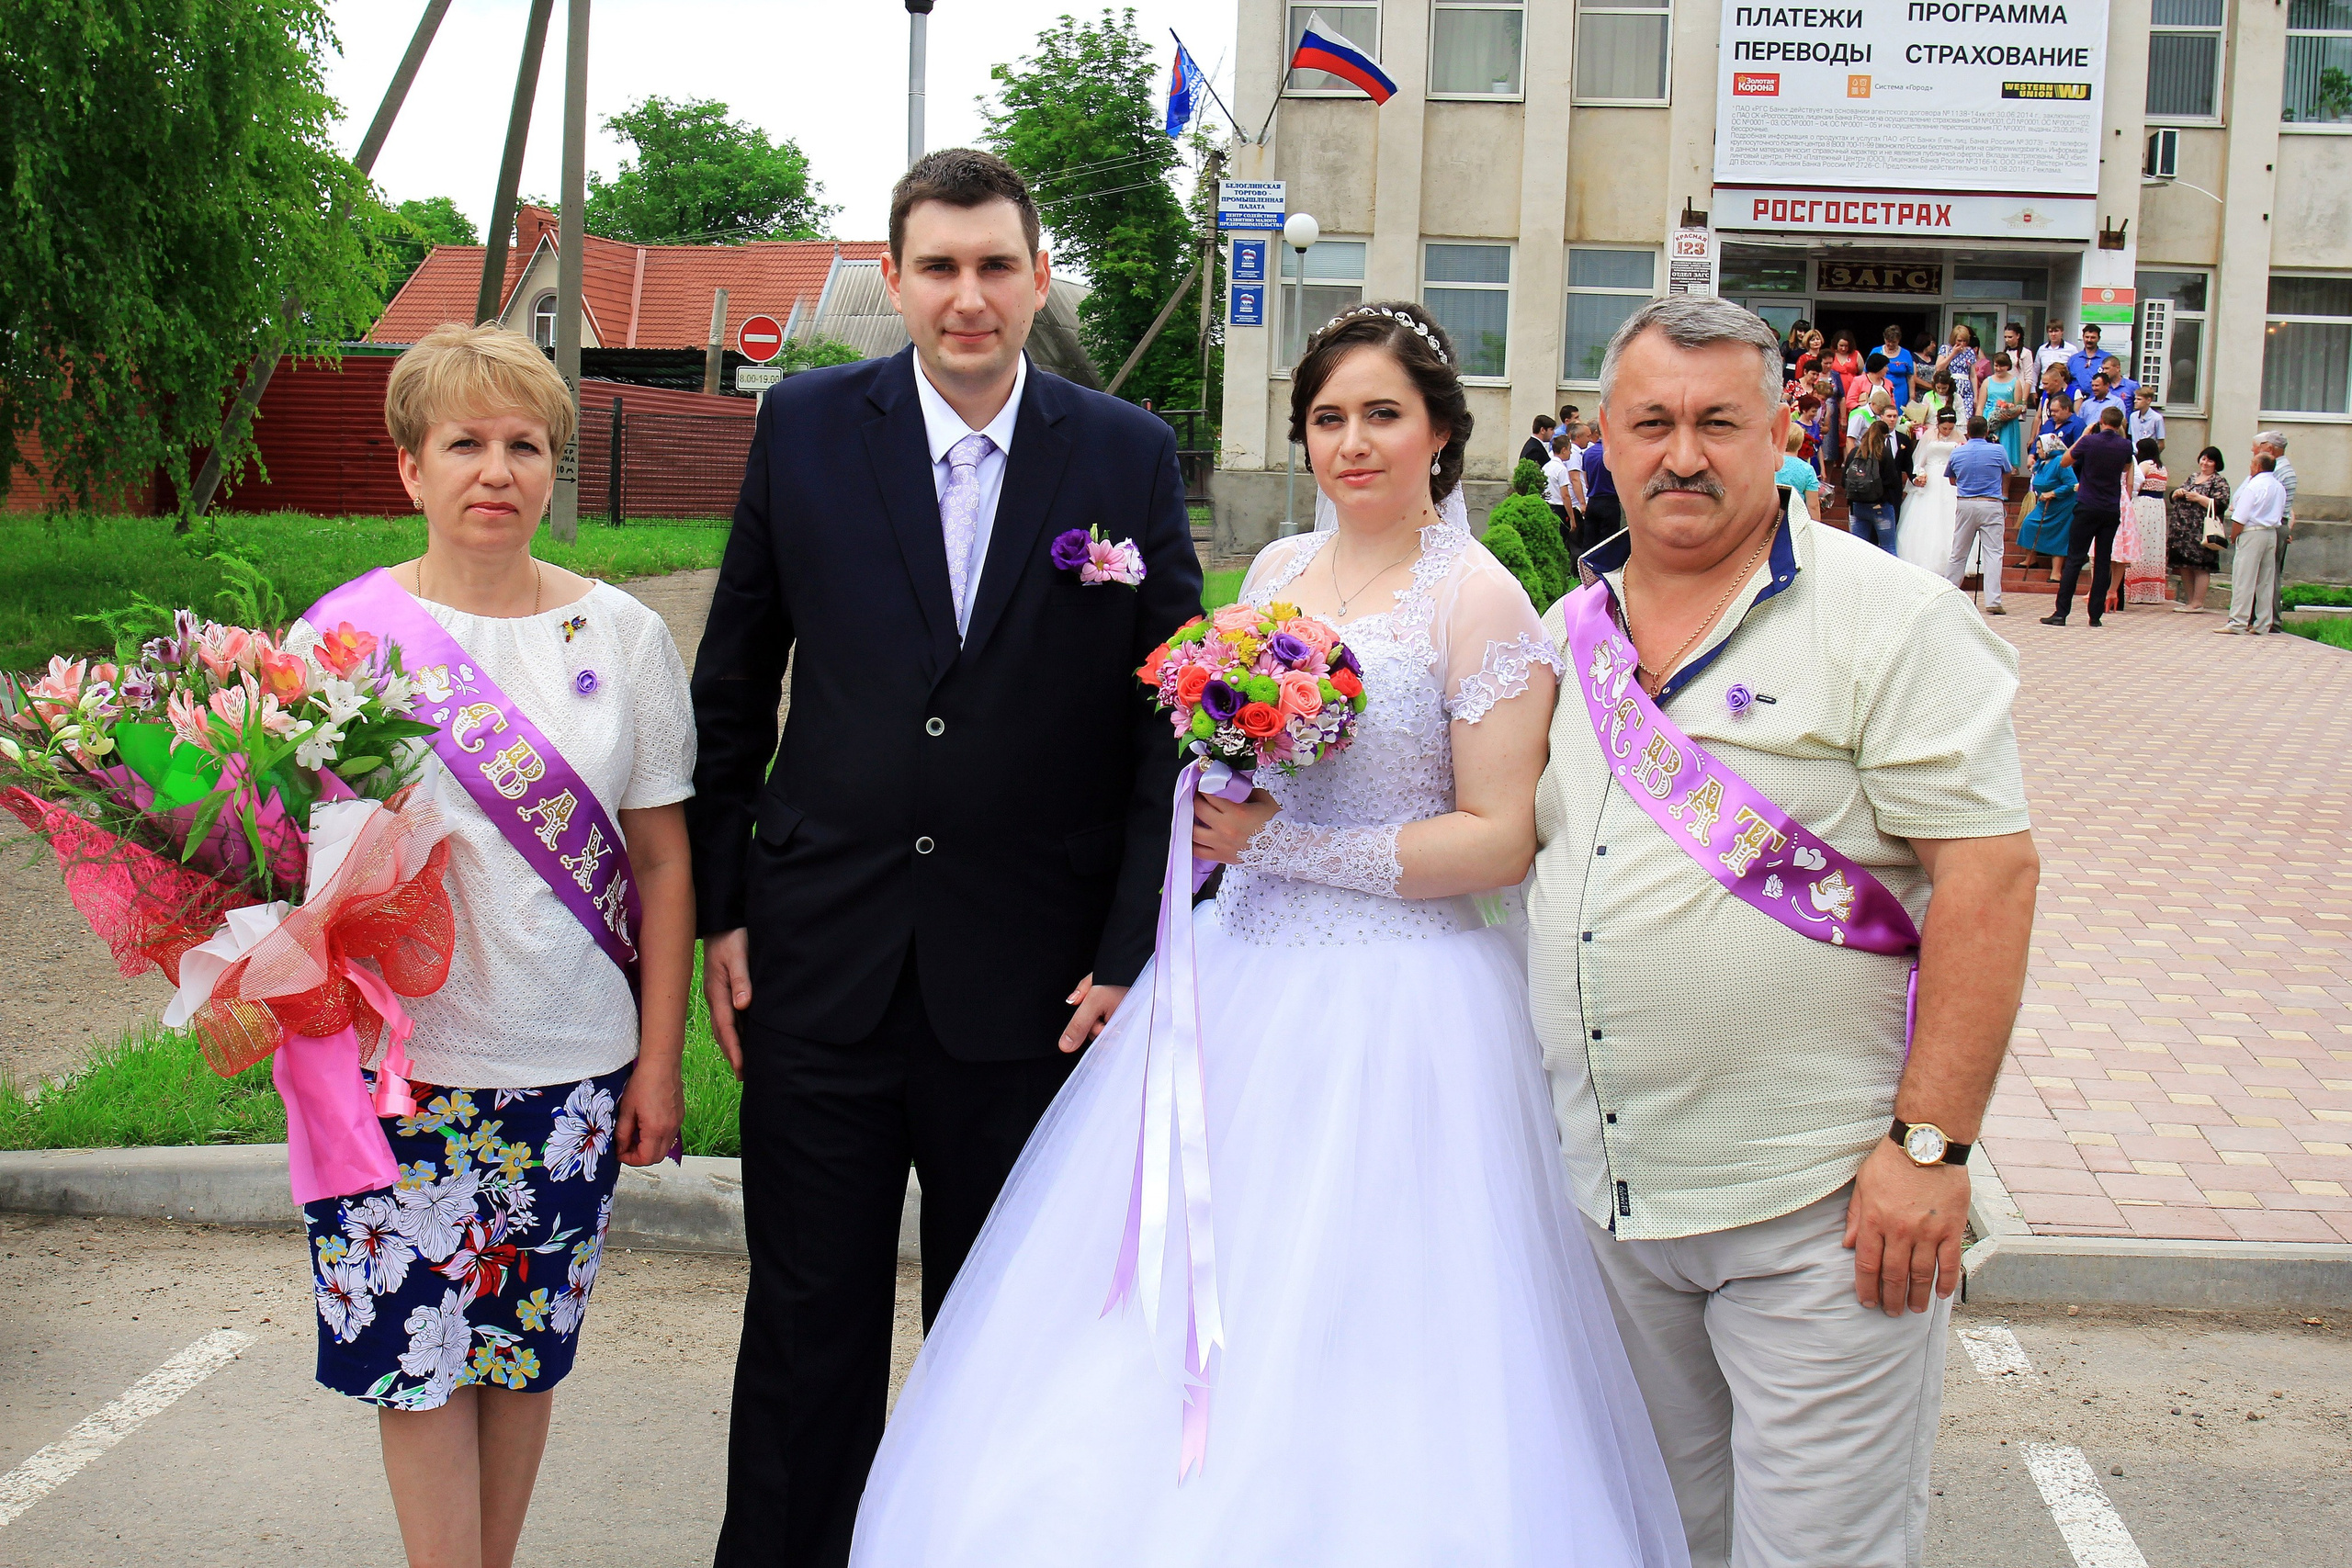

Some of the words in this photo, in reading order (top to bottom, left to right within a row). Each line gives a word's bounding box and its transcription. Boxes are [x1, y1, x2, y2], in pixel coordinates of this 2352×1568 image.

[1735, 7, 1863, 28] ПЛАТЕЖИ
[1907, 2, 2068, 25] ПРОГРАММА
[1734, 40, 1871, 66] ПЕРЕВОДЫ
[1738, 82, 1775, 93] Корона
[2004, 83, 2053, 91] WESTERN
[1752, 197, 1952, 228] РОСГОССТРАХ
[1675, 233, 1708, 243] КРАСНАЯ
[1677, 242, 1705, 255] 123
[1831, 267, 1928, 288] ЗАГС
[740, 374, 780, 384] 8.00-19.00
[1610, 696, 1789, 879] СВАТ
[450, 701, 621, 932] СВАХА
